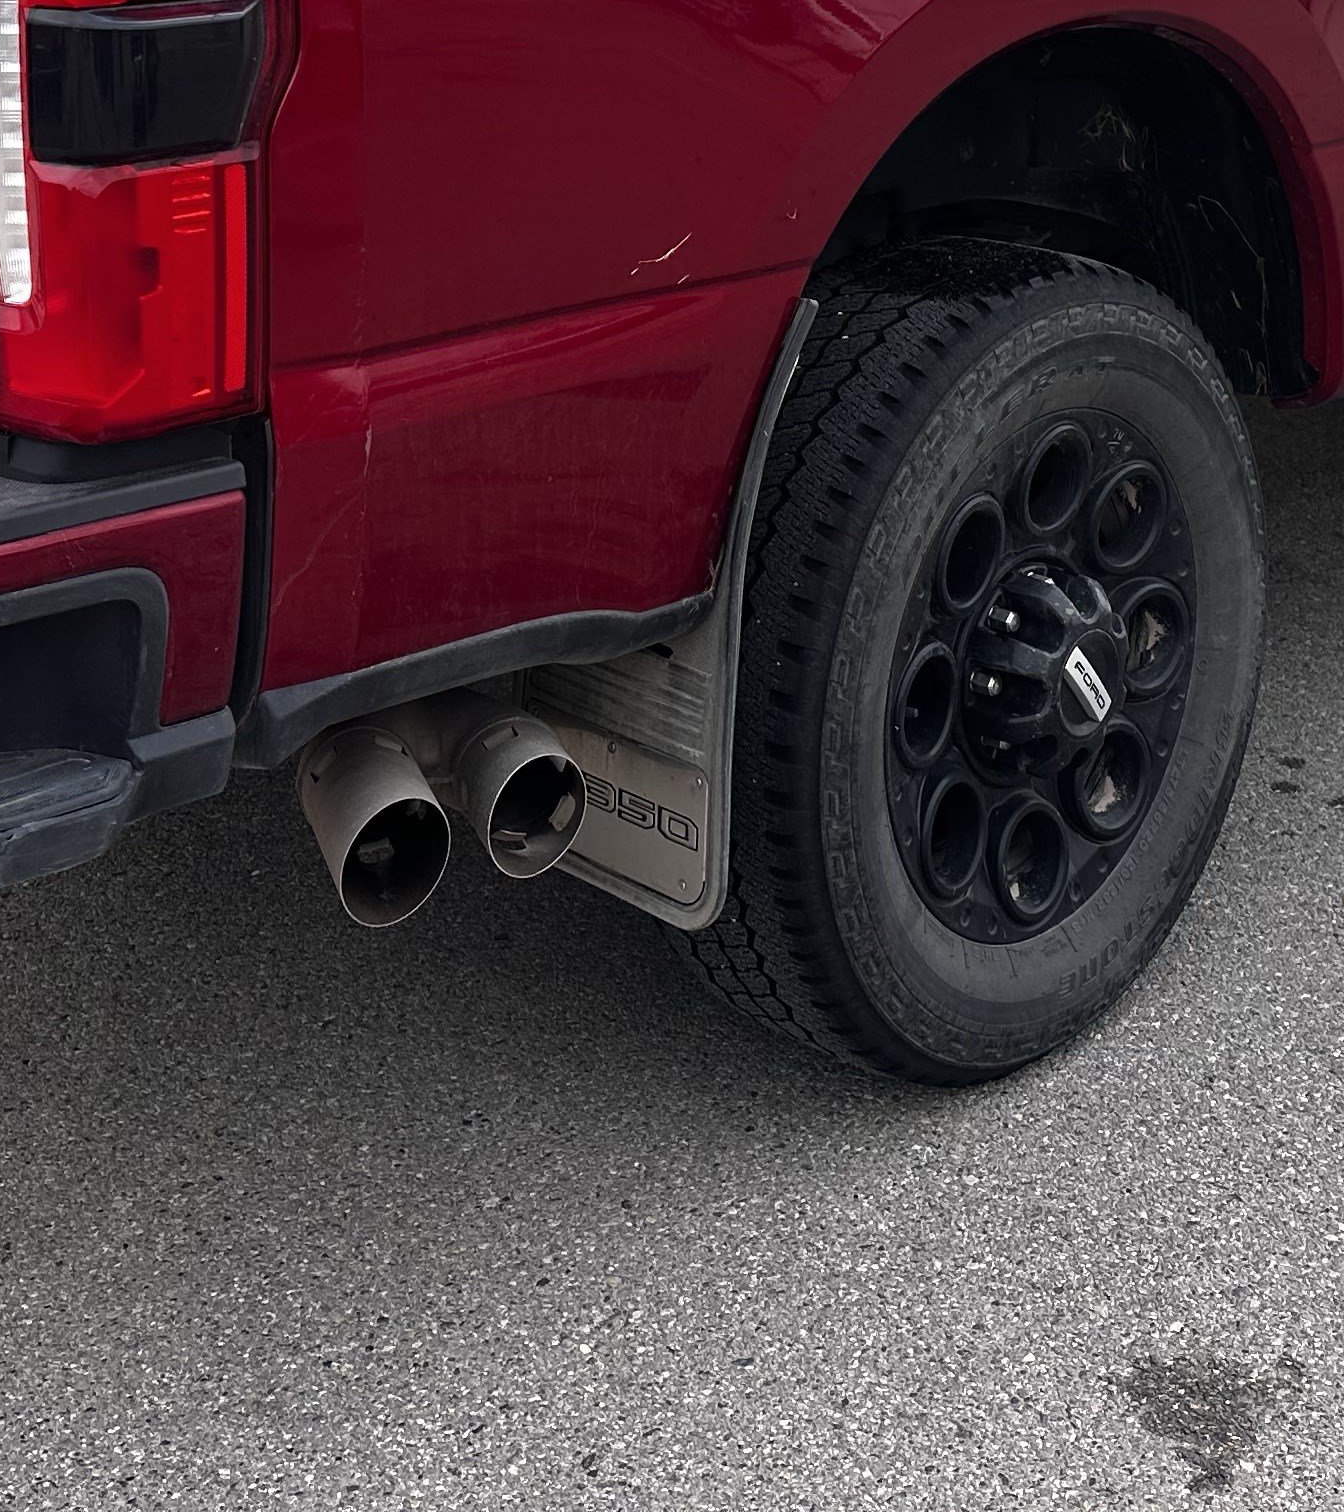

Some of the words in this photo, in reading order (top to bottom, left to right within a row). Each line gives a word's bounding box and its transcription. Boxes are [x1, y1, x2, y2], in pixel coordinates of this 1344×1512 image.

[1074, 661, 1106, 709] FORD
[584, 773, 699, 852] 350
[1056, 705, 1239, 1011] BRIDGESTONE
